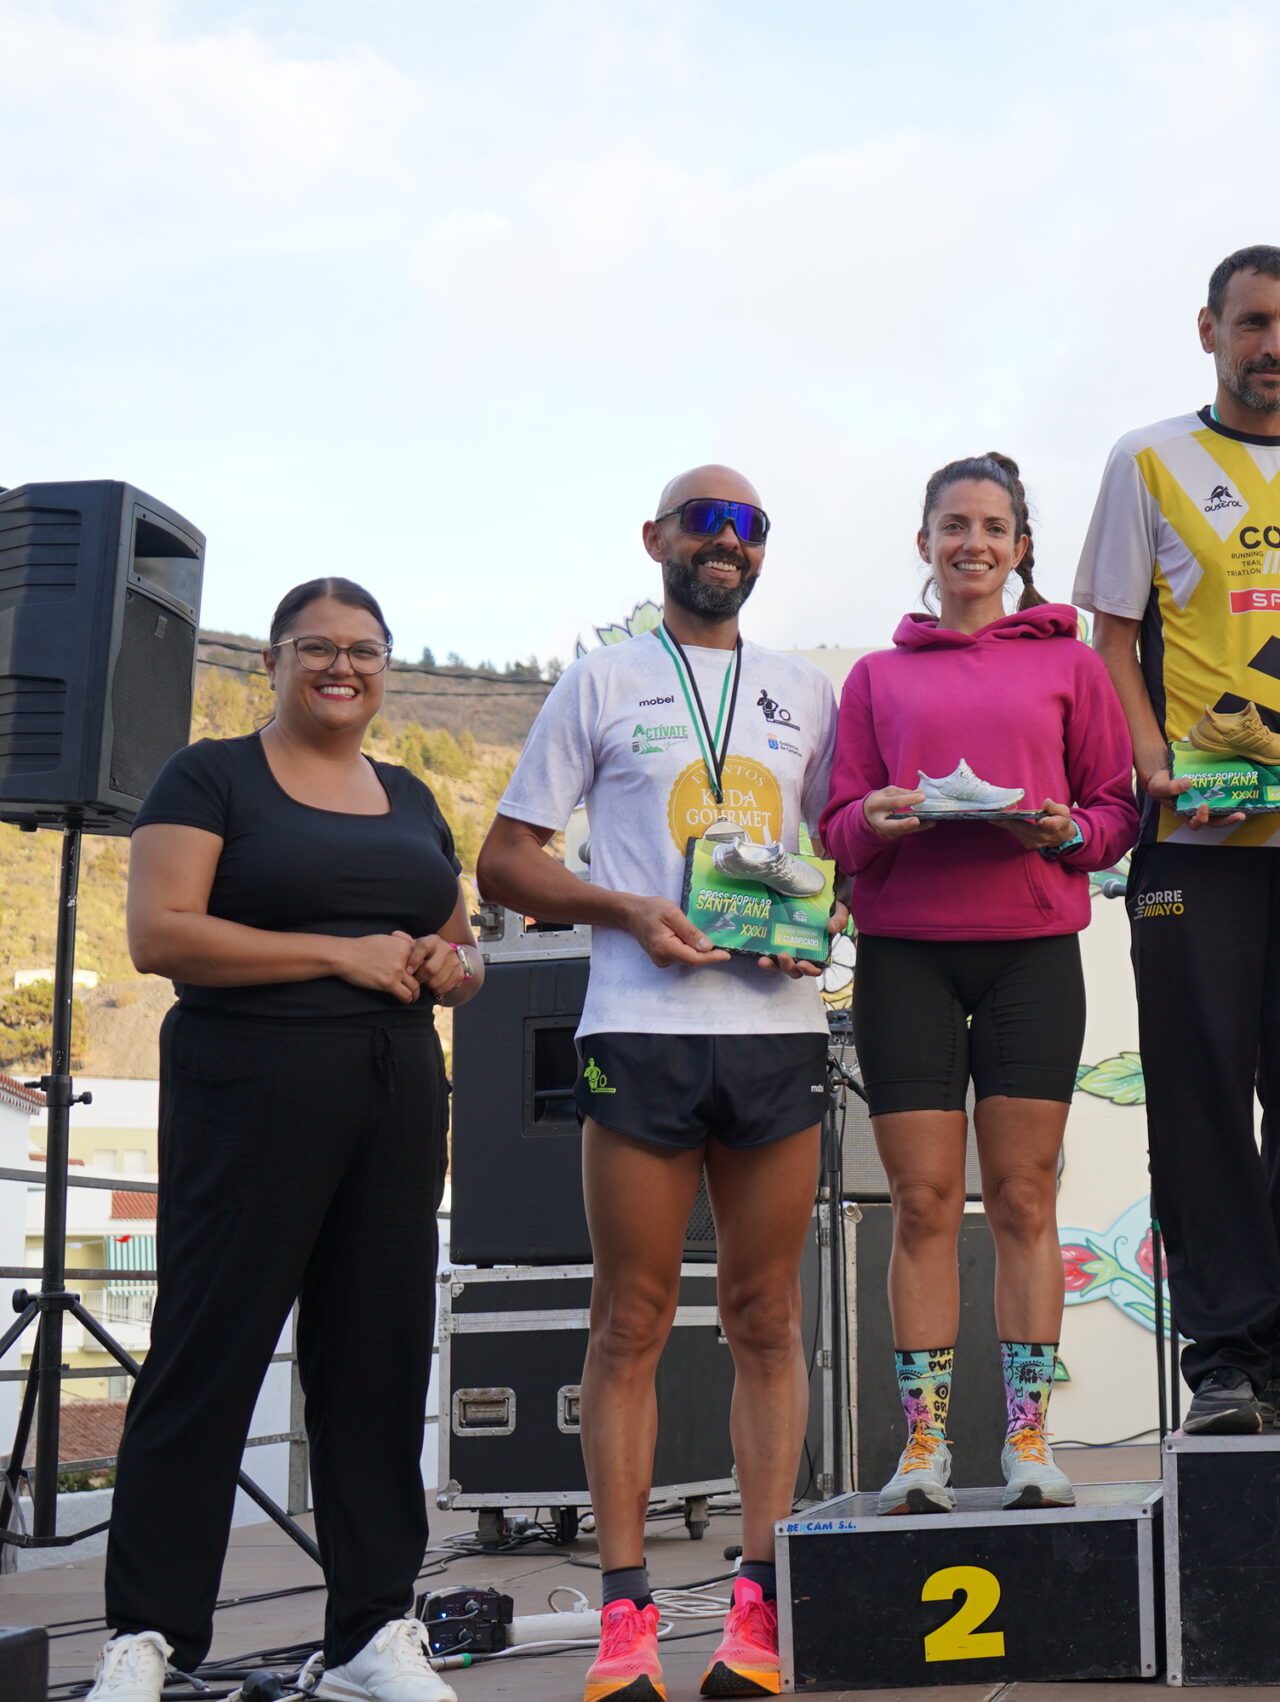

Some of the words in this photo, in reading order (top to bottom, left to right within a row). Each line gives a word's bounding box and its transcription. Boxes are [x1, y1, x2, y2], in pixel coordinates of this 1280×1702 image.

[1231, 551, 1264, 559] RUNNING
[1242, 559, 1263, 567] TRAIL
[1226, 568, 1262, 577] TRIATLON
[639, 695, 674, 707] mobel
[1191, 777, 1225, 788] ANTA
[1229, 775, 1259, 787] ANA
[1231, 790, 1259, 799] XXXII
[1137, 889, 1183, 906] CORRE
[696, 895, 738, 914] SANTA
[742, 902, 770, 919] ANA
[740, 923, 768, 938] XXXII
[920, 1565, 1006, 1662] 2
